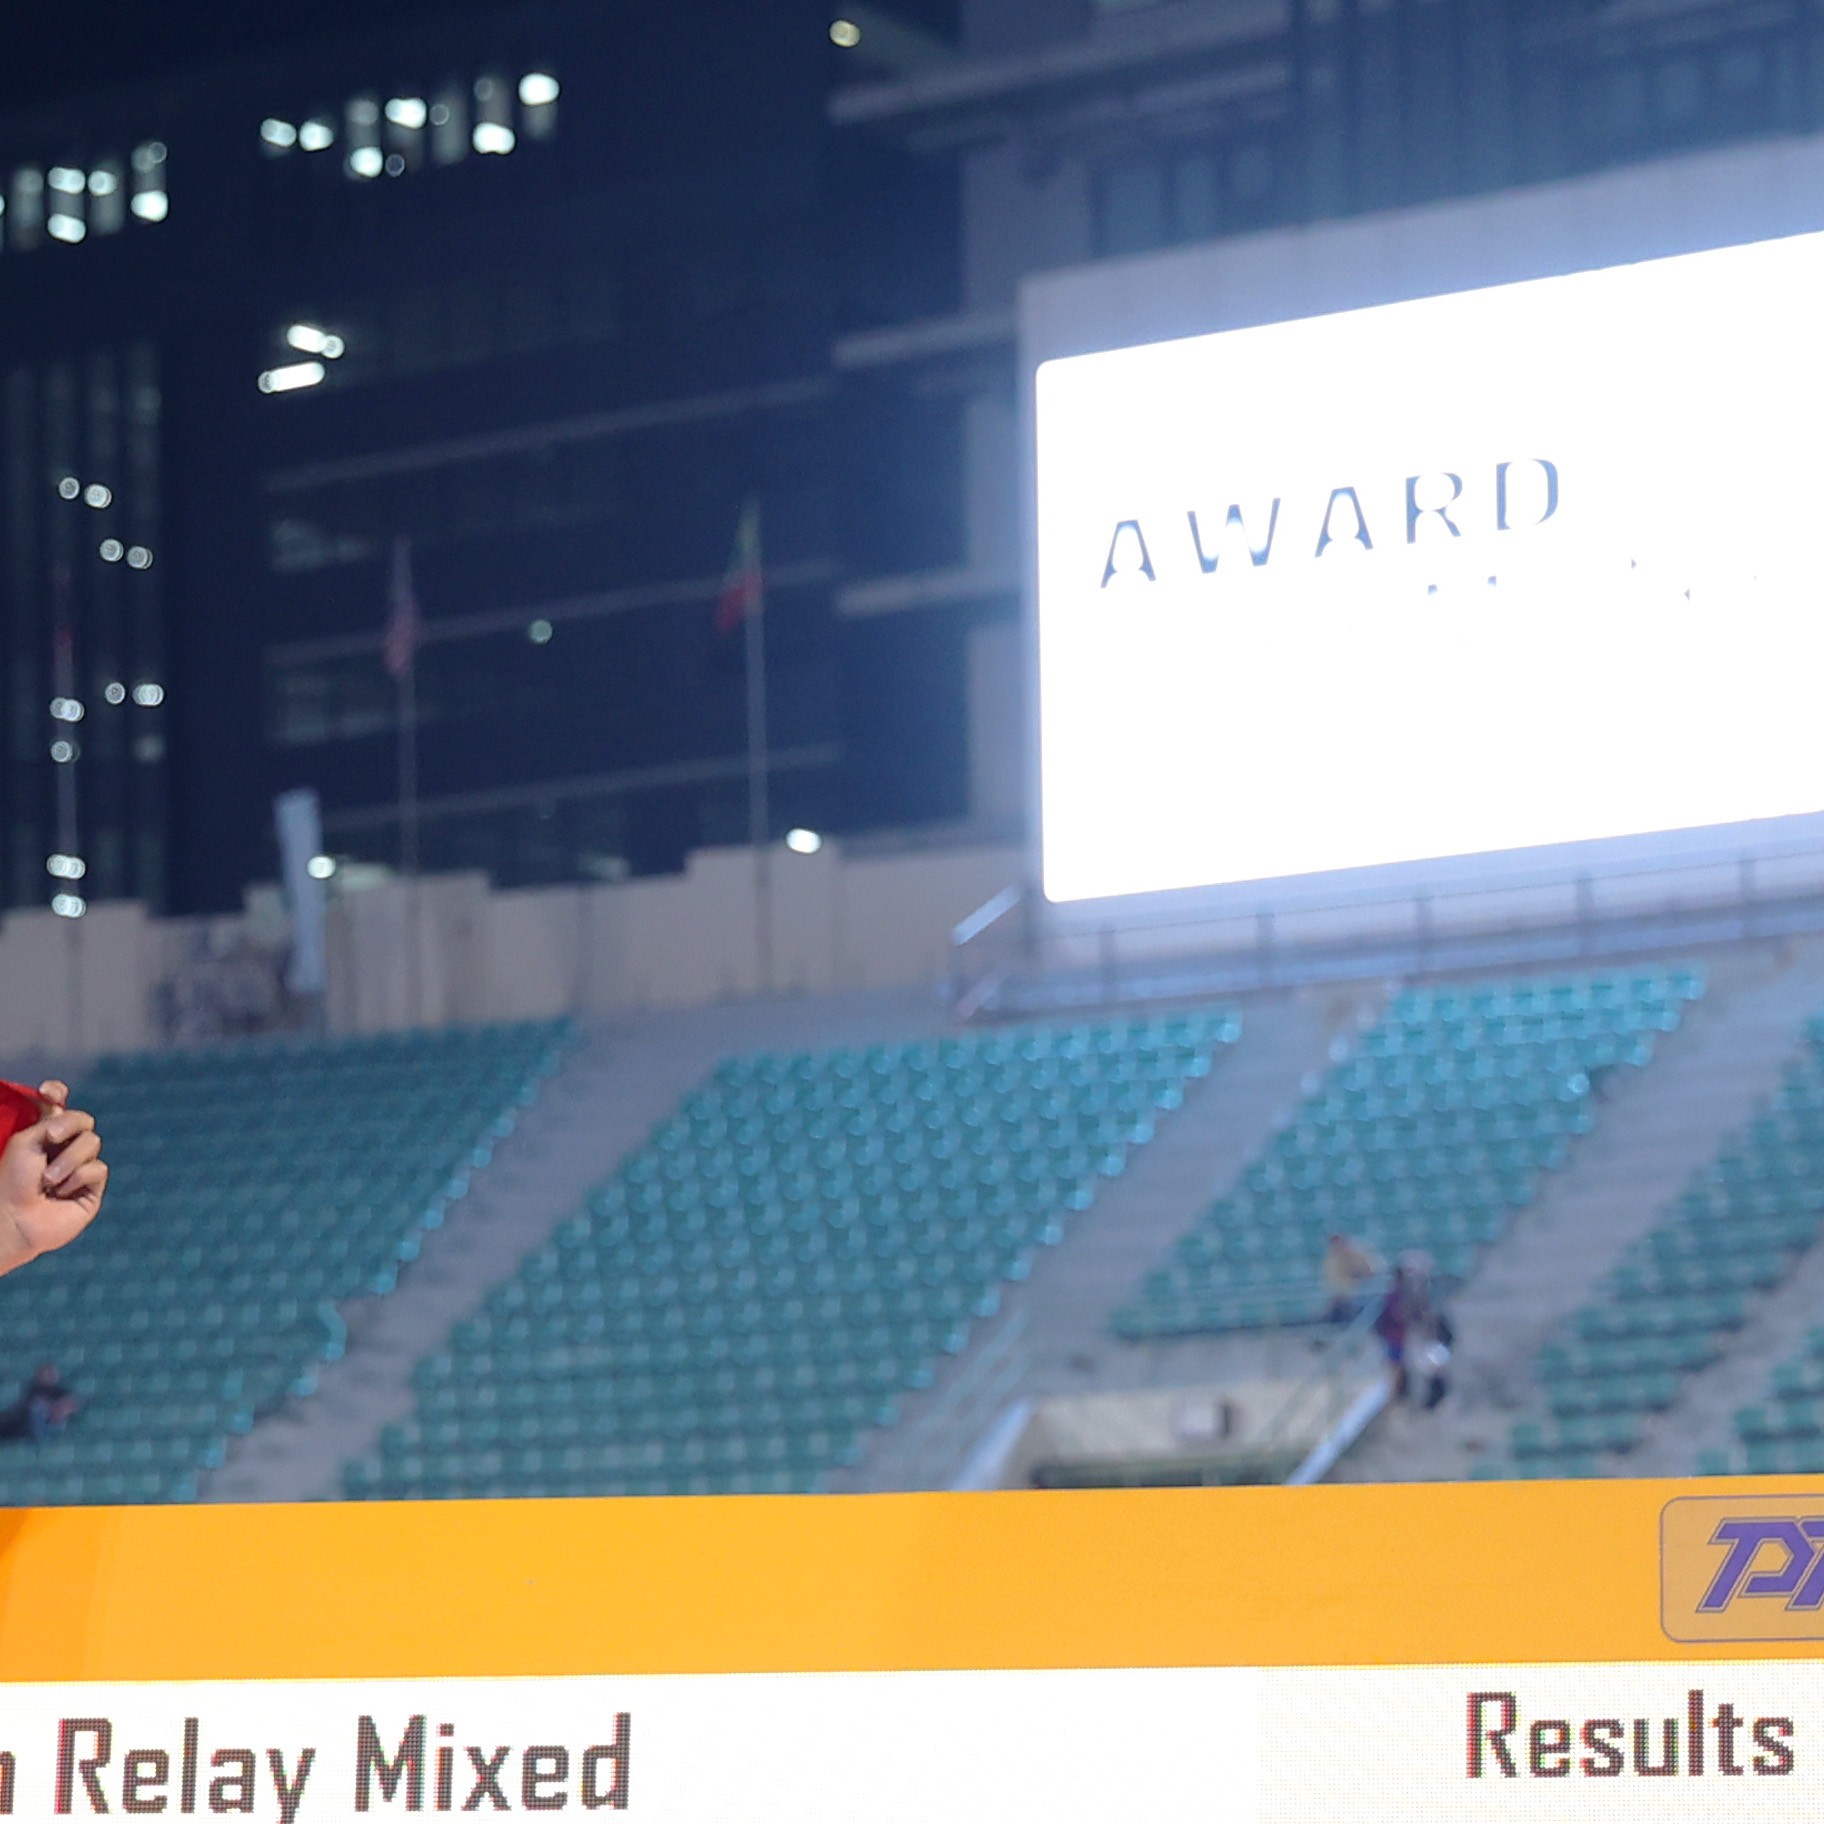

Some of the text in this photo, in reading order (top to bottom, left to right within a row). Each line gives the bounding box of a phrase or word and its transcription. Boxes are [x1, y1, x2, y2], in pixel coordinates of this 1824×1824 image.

[1099, 458, 1560, 590] AWARD
[354, 1711, 632, 1814] Mixed
[1465, 1688, 1795, 1780] Results
